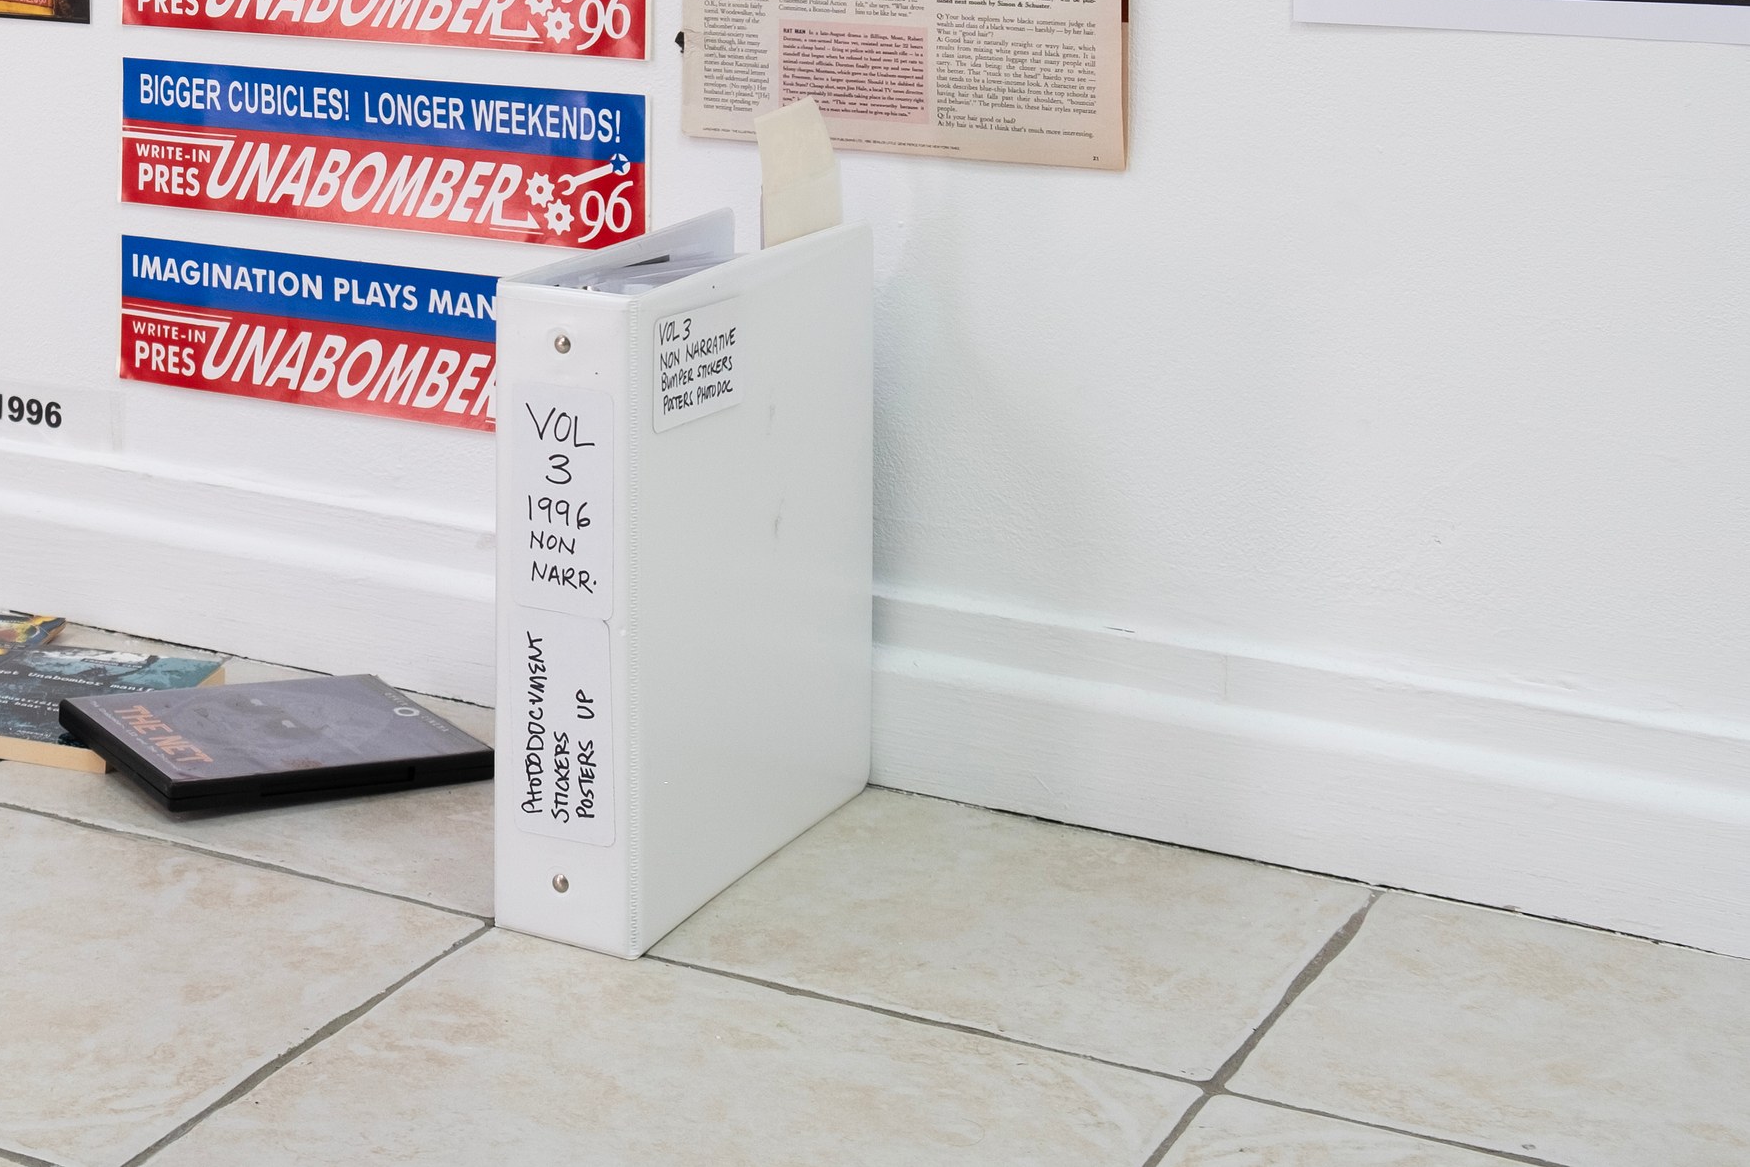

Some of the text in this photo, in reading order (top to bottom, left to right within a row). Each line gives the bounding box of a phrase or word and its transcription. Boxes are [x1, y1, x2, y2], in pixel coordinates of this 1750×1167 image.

[139, 72, 622, 144] BIGGER CUBICLES! LONGER WEEKENDS!
[131, 253, 324, 301] IMAGINATION
[334, 281, 418, 311] PLAYS
[659, 318, 691, 345] VOL 3
[660, 327, 736, 371] NON NARRATIVE
[661, 356, 733, 392] BUMPER STICKERS
[663, 391, 693, 415] POSTERS
[526, 403, 595, 447] VOL
[545, 454, 574, 484] 3
[527, 495, 591, 529] 1996
[530, 530, 576, 555] NON
[531, 561, 597, 593] NARR.
[114, 705, 213, 764] THE NET
[576, 689, 596, 819] POSTERS UP
[551, 731, 569, 823] STICKERS
